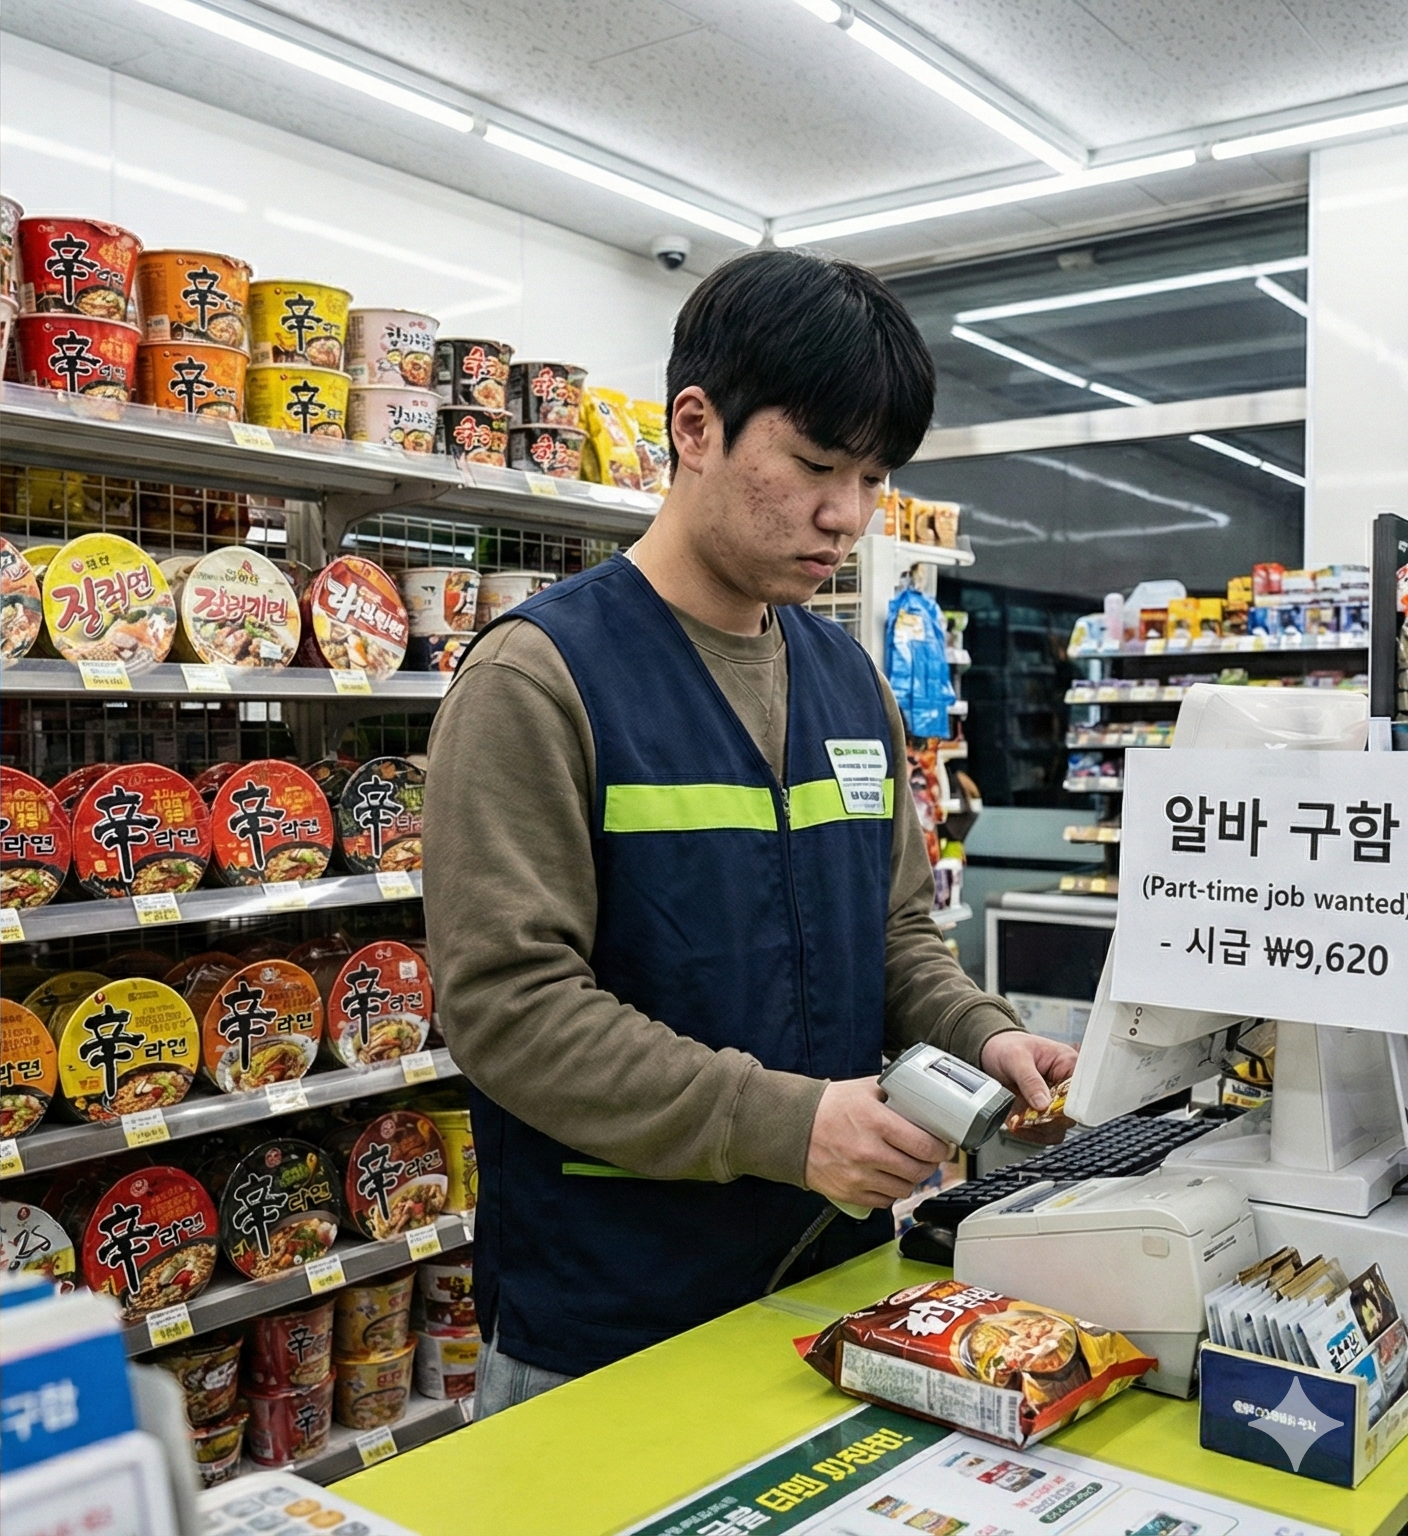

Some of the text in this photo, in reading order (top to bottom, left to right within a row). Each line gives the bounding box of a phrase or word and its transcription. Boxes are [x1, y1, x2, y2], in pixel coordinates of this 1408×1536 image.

[46, 232, 99, 305] 辛
[182, 266, 228, 332] 辛
[282, 293, 323, 353] 辛
[49, 330, 101, 393] 辛
[169, 356, 215, 413] 辛
[287, 380, 326, 434] 辛
[3, 834, 55, 857] 라면
[93, 785, 160, 882] 辛
[228, 780, 286, 870] 辛
[354, 775, 404, 858] 辛
[1165, 796, 1400, 863] 알바 구함
[1143, 873, 1259, 904] (Part-time
[1264, 884, 1305, 911] job
[1186, 926, 1251, 967] 시급
[1263, 935, 1389, 976] ₩9,620
[218, 981, 277, 1072] 辛
[342, 961, 391, 1046] 辛
[78, 1003, 145, 1099] 辛
[233, 1173, 289, 1259] 辛
[358, 1143, 404, 1223] 辛
[97, 1203, 158, 1295] 辛
[287, 1323, 315, 1363] 辛
